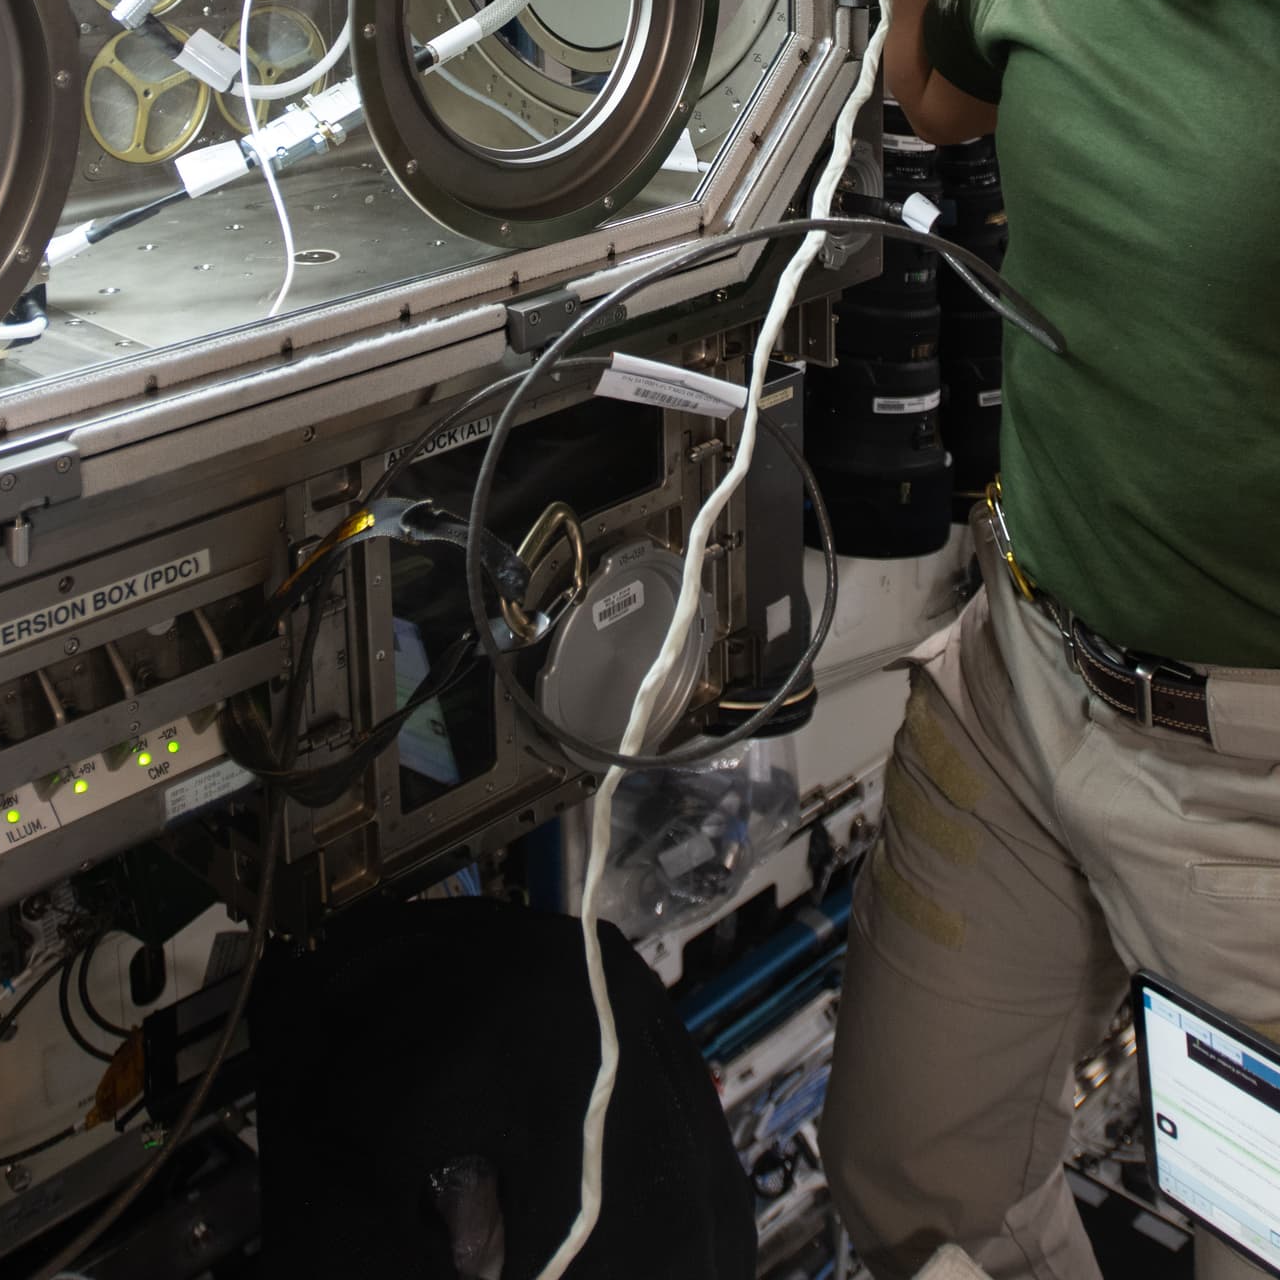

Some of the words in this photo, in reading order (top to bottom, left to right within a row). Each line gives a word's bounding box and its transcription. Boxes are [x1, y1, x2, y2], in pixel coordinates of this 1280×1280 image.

[460, 418, 491, 441] (AL)
[93, 578, 138, 612] BOX
[143, 556, 200, 594] (PDC)
[147, 761, 170, 781] CMP
[5, 820, 47, 844] ILLUM.
